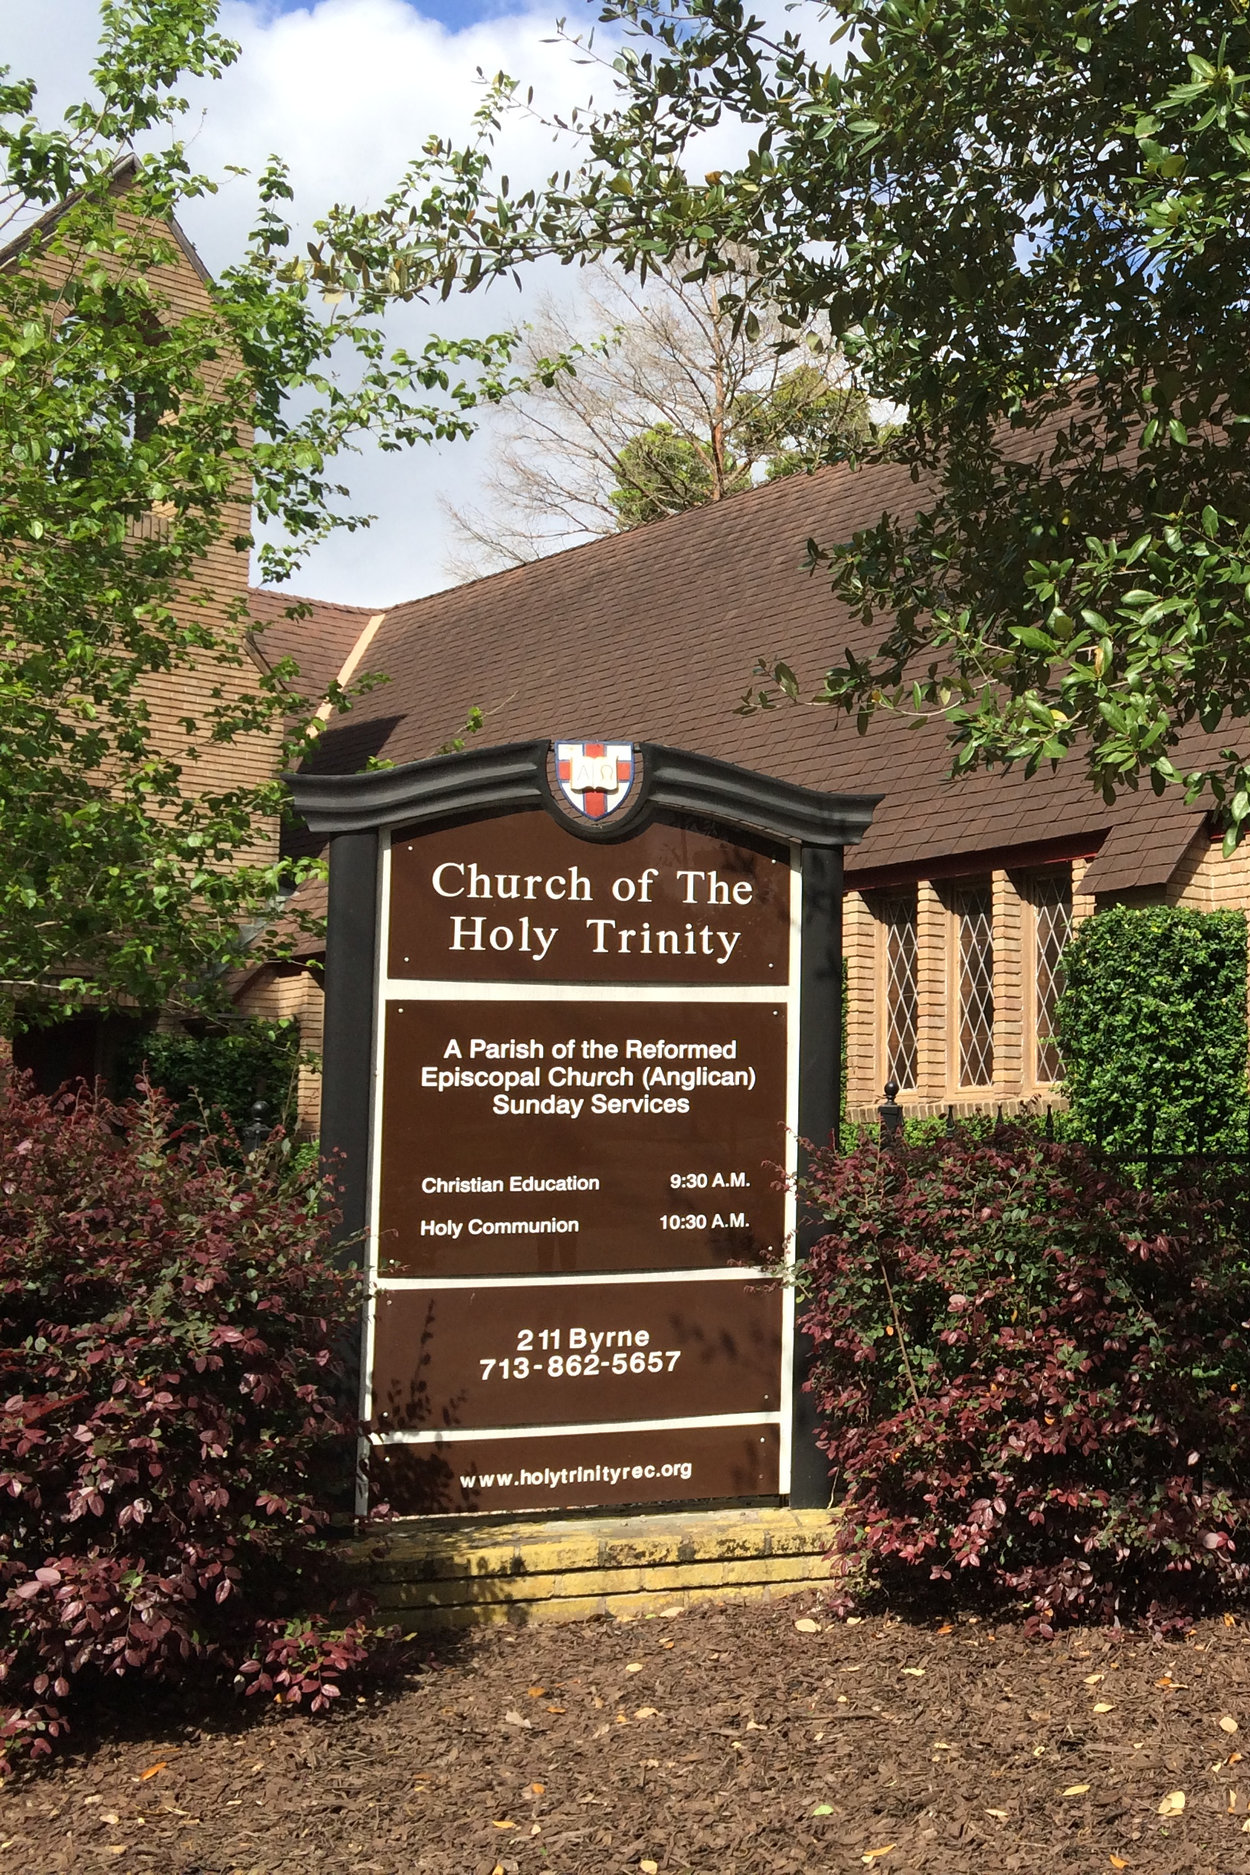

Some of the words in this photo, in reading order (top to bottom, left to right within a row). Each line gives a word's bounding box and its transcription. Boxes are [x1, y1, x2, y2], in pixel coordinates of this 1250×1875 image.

[432, 863, 594, 901] Church
[612, 868, 659, 903] of
[677, 871, 753, 905] The
[449, 916, 558, 961] Holy
[586, 919, 742, 965] Trinity
[444, 1039, 462, 1058] A
[469, 1039, 544, 1059] Parish
[552, 1039, 576, 1059] of
[581, 1040, 619, 1059] the
[626, 1039, 737, 1060] Reformed
[422, 1066, 541, 1092] Episcopal
[548, 1066, 634, 1087] Church
[642, 1066, 756, 1091] (Anglican)
[493, 1094, 585, 1119] Sunday
[591, 1093, 690, 1115] Services
[421, 1176, 504, 1194] Christian
[510, 1175, 600, 1192] Education
[670, 1173, 708, 1189] 9:30
[712, 1173, 750, 1188] A.M.
[420, 1219, 464, 1239] Holy
[468, 1217, 579, 1235] Communion
[659, 1214, 707, 1230] 10:30
[711, 1212, 749, 1229] A.M.
[517, 1330, 561, 1352] 211
[570, 1328, 650, 1354] Byrne
[479, 1351, 681, 1381] 713-862-5657
[460, 1462, 693, 1489] www.holytrinityrec.org
